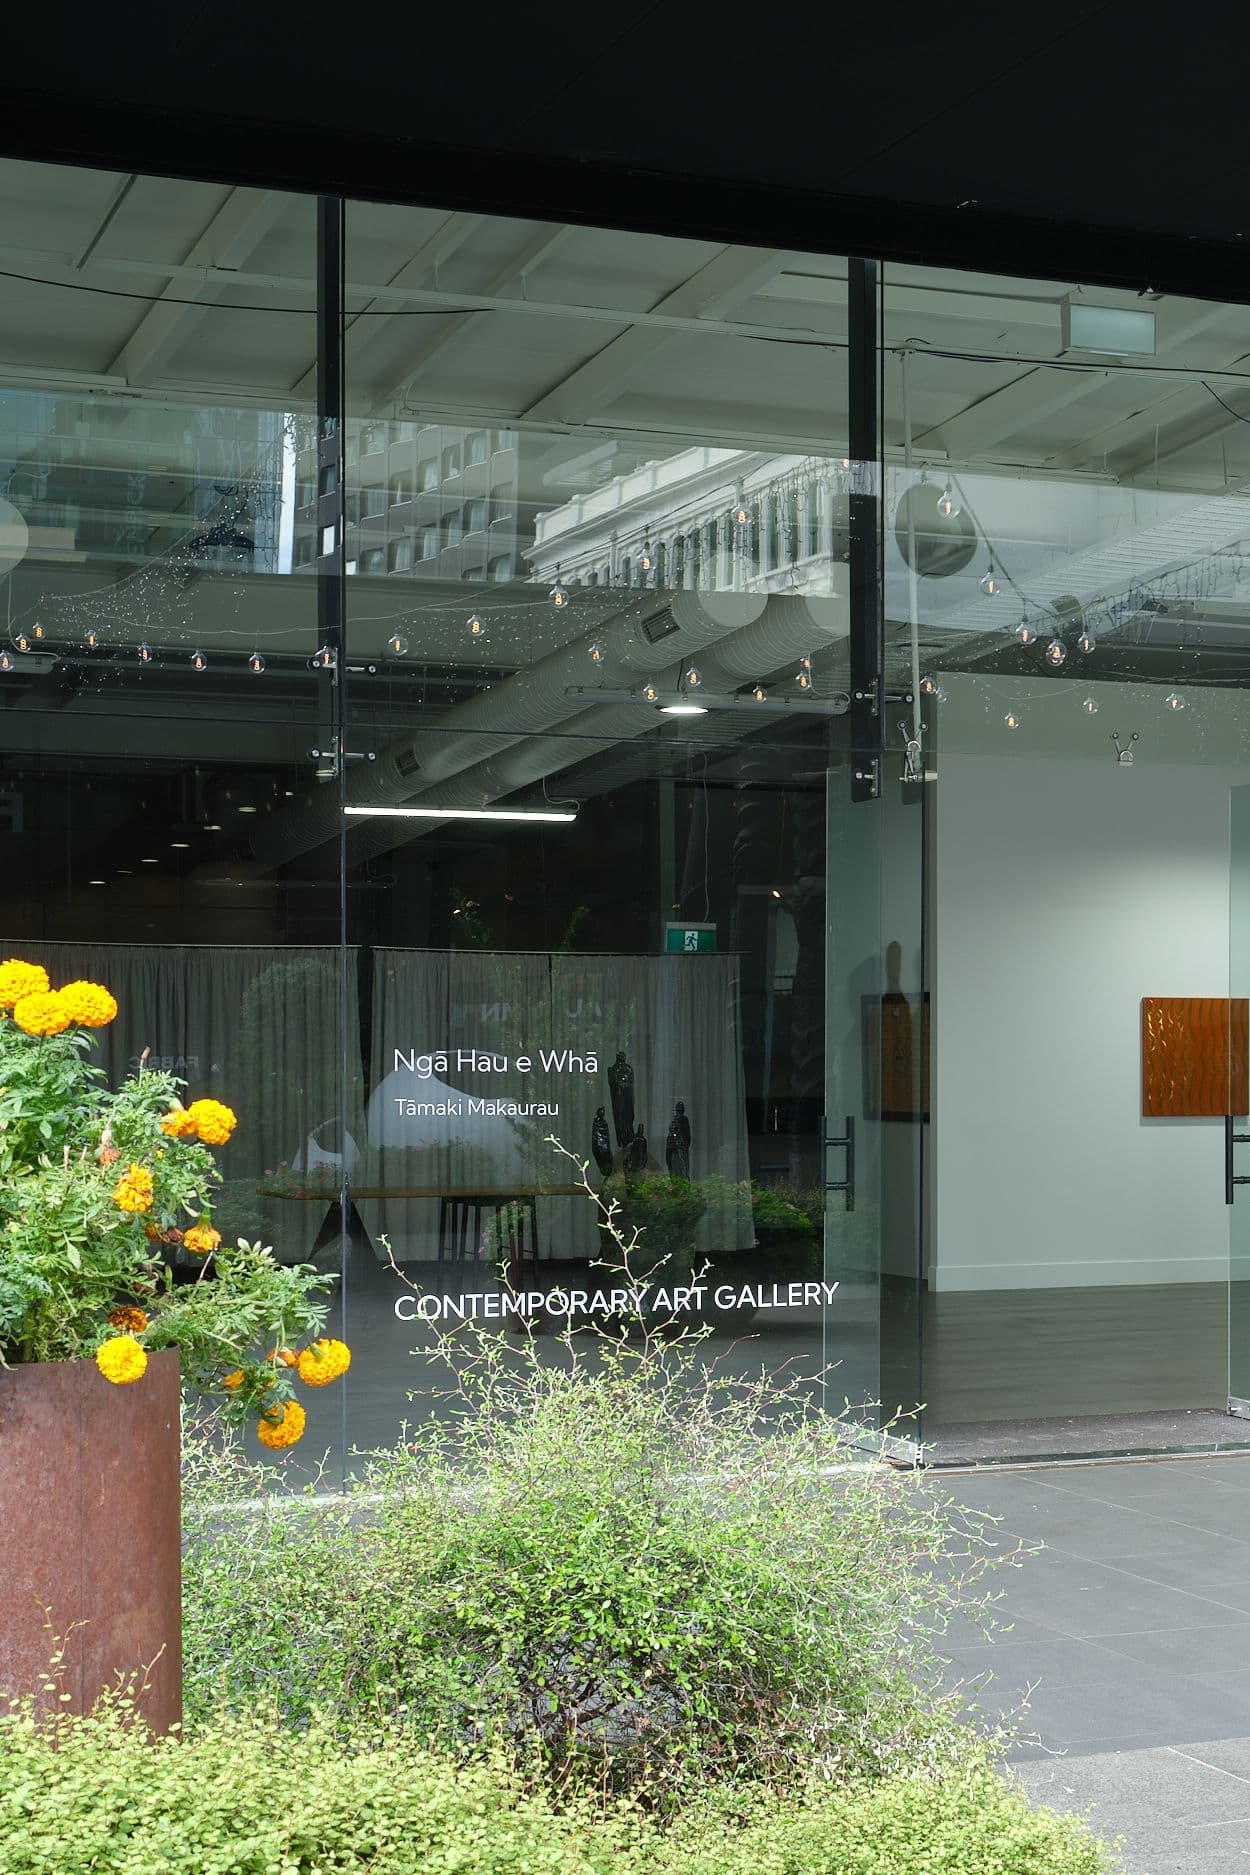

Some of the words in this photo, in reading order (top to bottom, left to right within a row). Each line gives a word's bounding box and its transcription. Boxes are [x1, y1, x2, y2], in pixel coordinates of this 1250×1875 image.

[394, 1048, 448, 1079] Ngā
[457, 1048, 508, 1072] Hau
[515, 1055, 532, 1073] e
[538, 1049, 598, 1073] Whā
[394, 1098, 462, 1116] Tāmaki
[467, 1098, 559, 1116] Makaurau
[394, 1287, 648, 1321] CONTEMPORARY
[651, 1286, 709, 1312] ART
[714, 1281, 840, 1310] GALLERY
